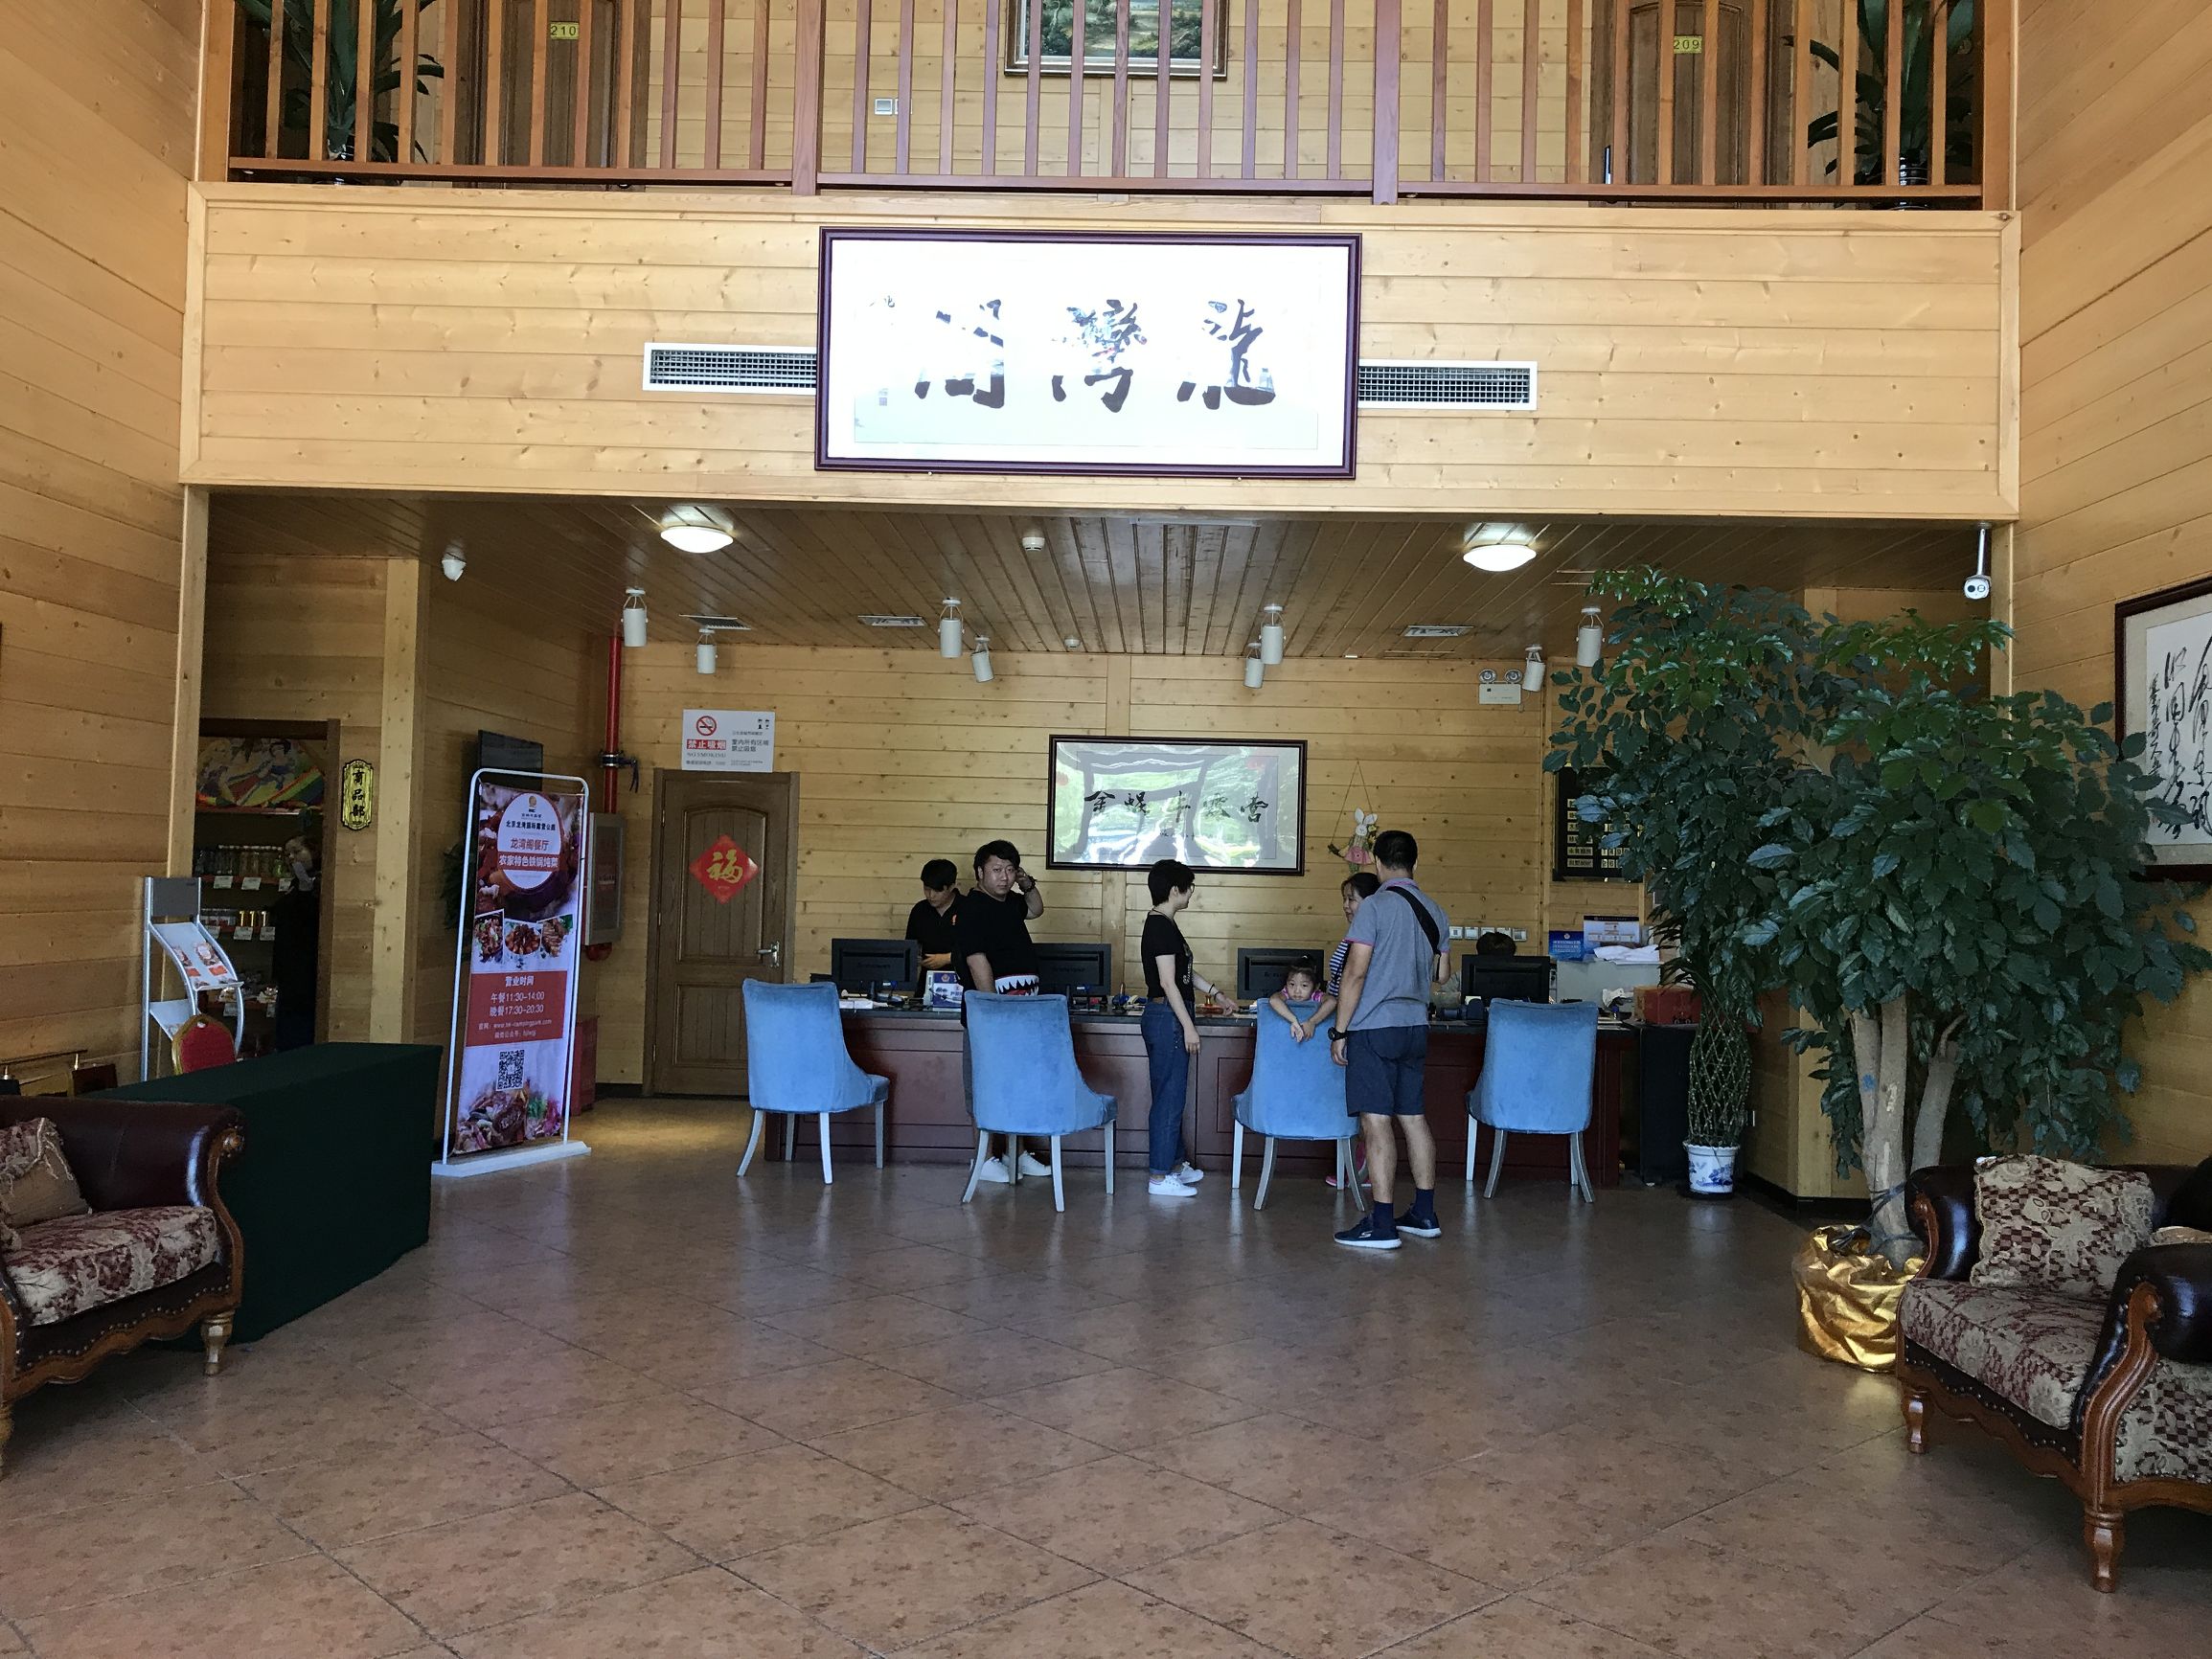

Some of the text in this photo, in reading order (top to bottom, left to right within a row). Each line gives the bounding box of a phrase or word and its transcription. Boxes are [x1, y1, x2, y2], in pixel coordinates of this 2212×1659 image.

[551, 25, 577, 35] 210
[1674, 39, 1699, 49] 209
[687, 739, 726, 750] 禁止吸烟
[350, 769, 365, 817] 商品部
[510, 837, 550, 852] 龙湾阁餐厅
[706, 849, 743, 884] 福
[505, 975, 535, 988] 营业时间
